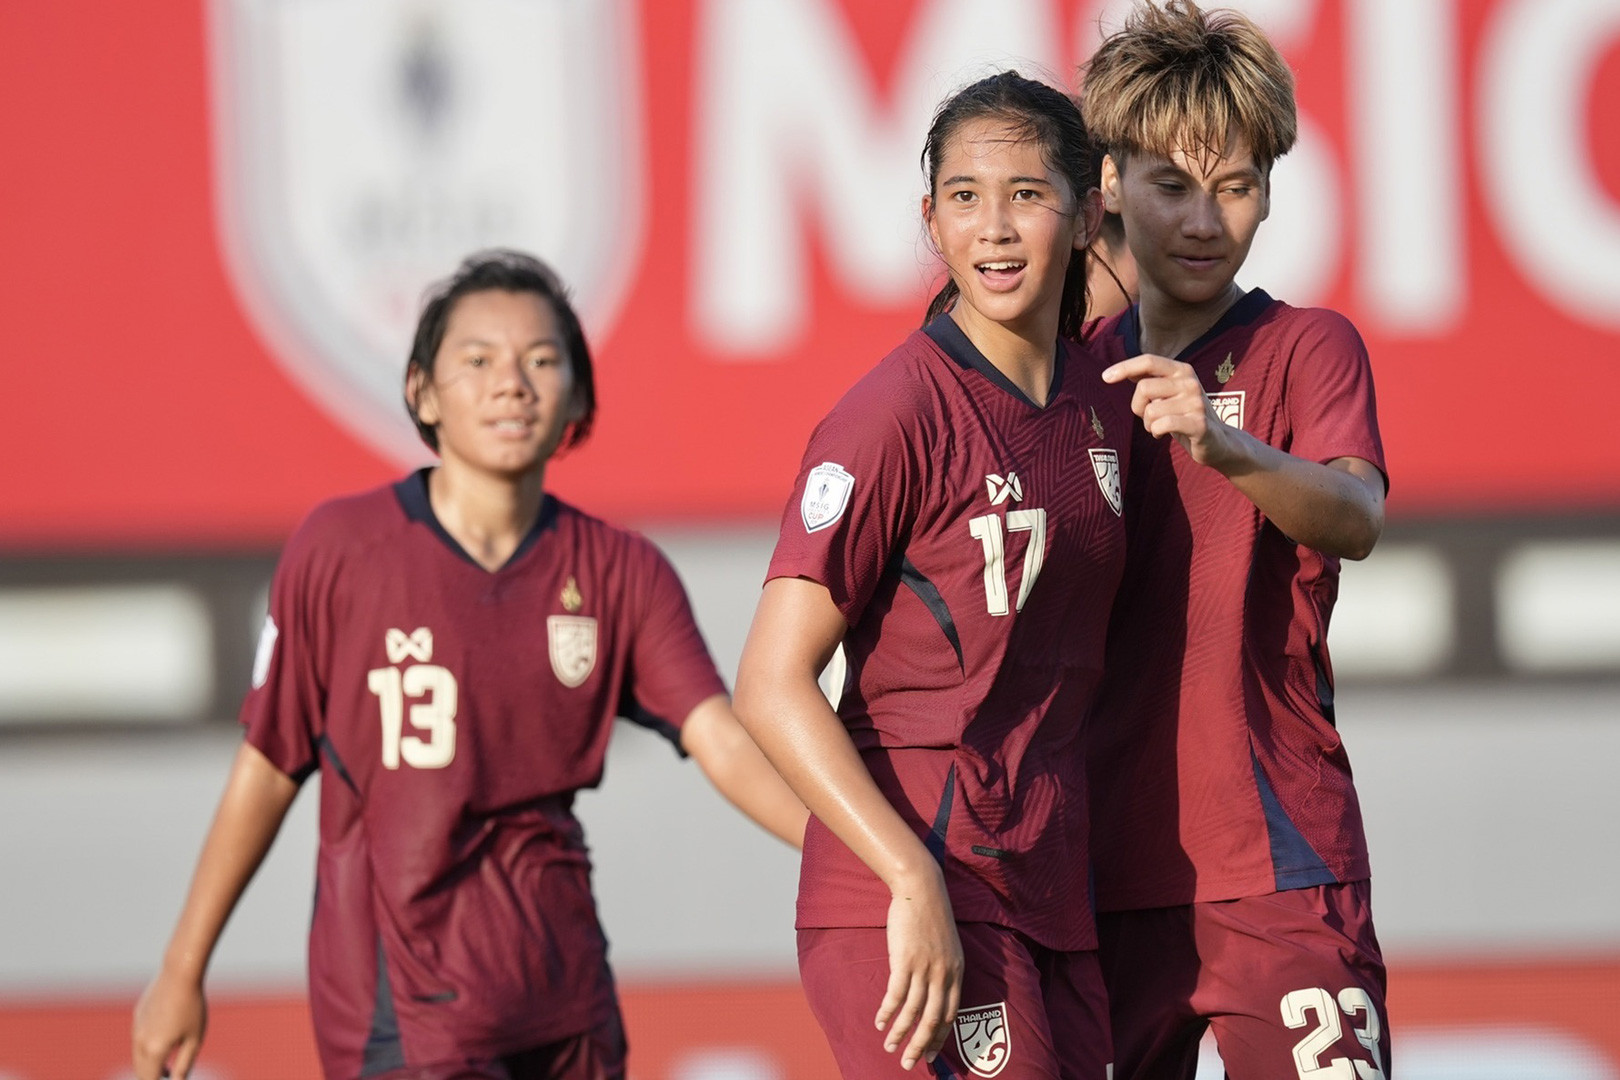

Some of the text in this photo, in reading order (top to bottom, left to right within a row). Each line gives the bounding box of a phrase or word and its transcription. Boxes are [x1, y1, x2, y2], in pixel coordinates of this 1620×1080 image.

[1209, 397, 1240, 406] AILAND
[968, 507, 1047, 617] 17
[367, 664, 458, 770] 13
[957, 1009, 1002, 1024] THAILAND
[1280, 987, 1387, 1080] 23
